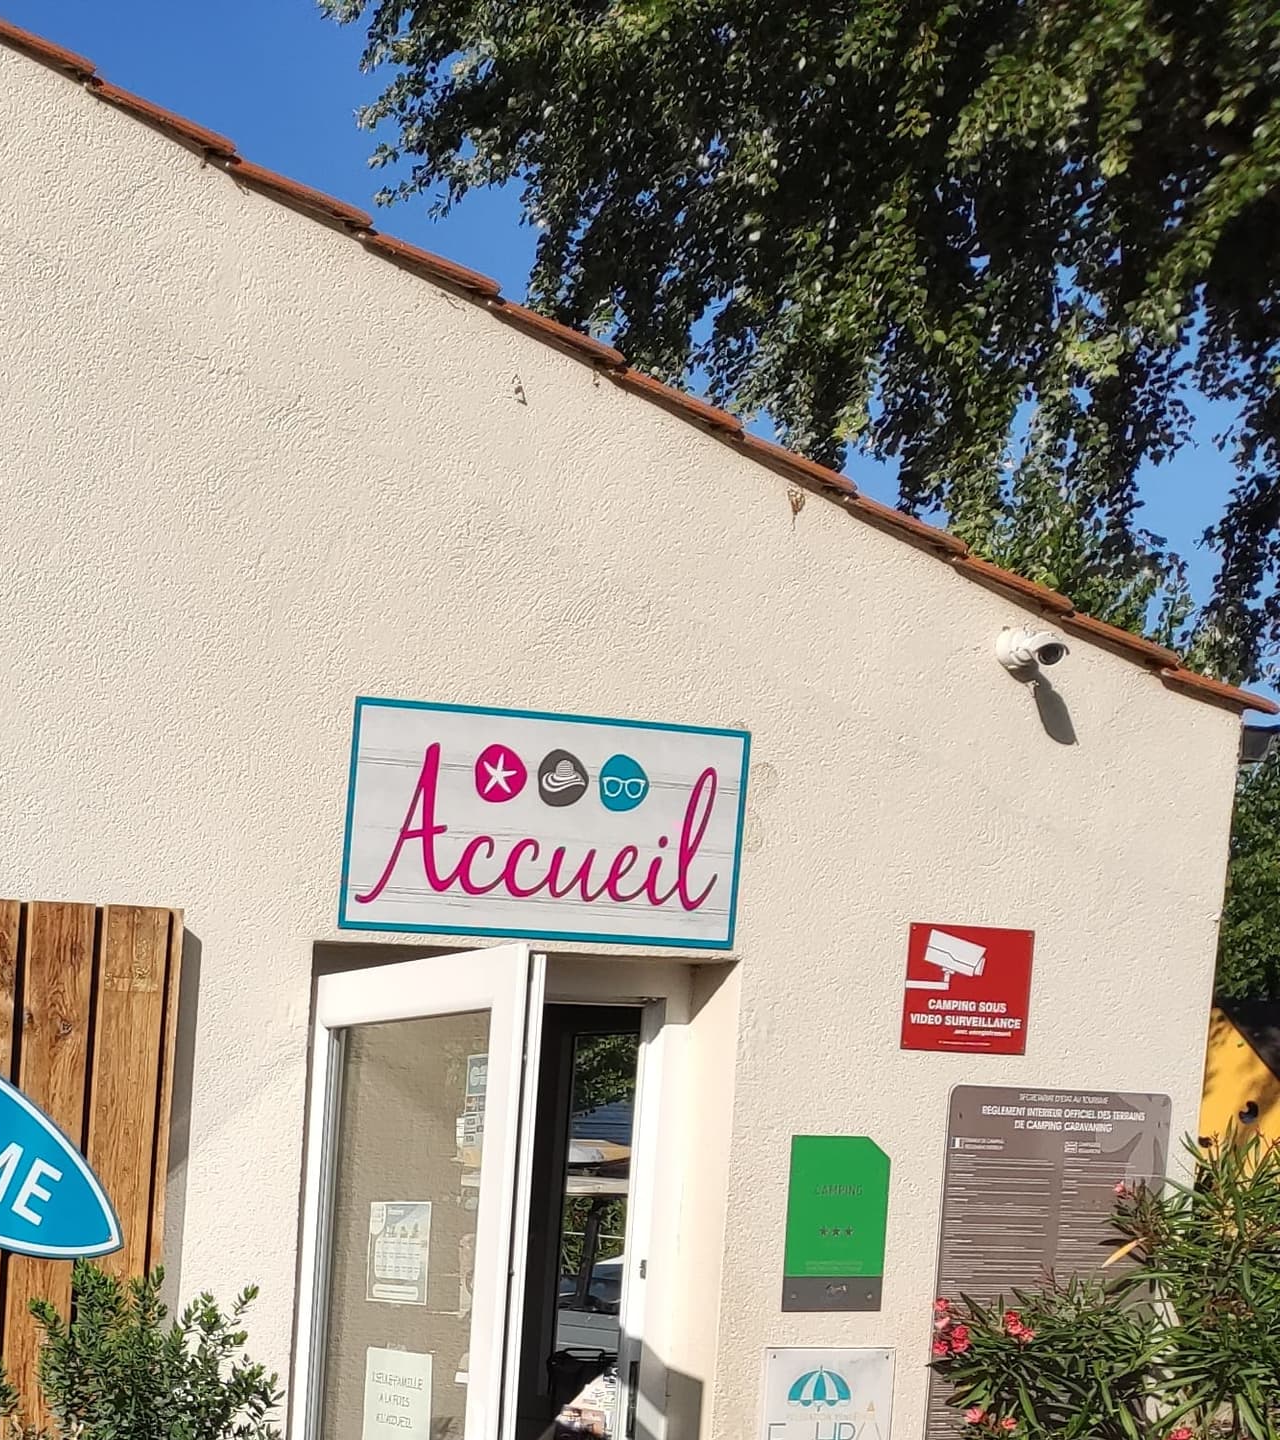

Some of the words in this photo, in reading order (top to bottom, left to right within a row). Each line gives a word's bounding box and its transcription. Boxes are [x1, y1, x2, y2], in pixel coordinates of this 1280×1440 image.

[354, 741, 719, 912] Accueil
[928, 999, 977, 1012] CAMPING
[979, 1001, 1007, 1013] SOUS
[910, 1013, 943, 1025] VIDEO
[945, 1015, 1022, 1029] SURVEILLANCE
[1064, 1109, 1097, 1119] OFFICIEL
[1097, 1110, 1112, 1120] DES
[1014, 1120, 1025, 1129] DE
[1026, 1120, 1062, 1131] CAMPING
